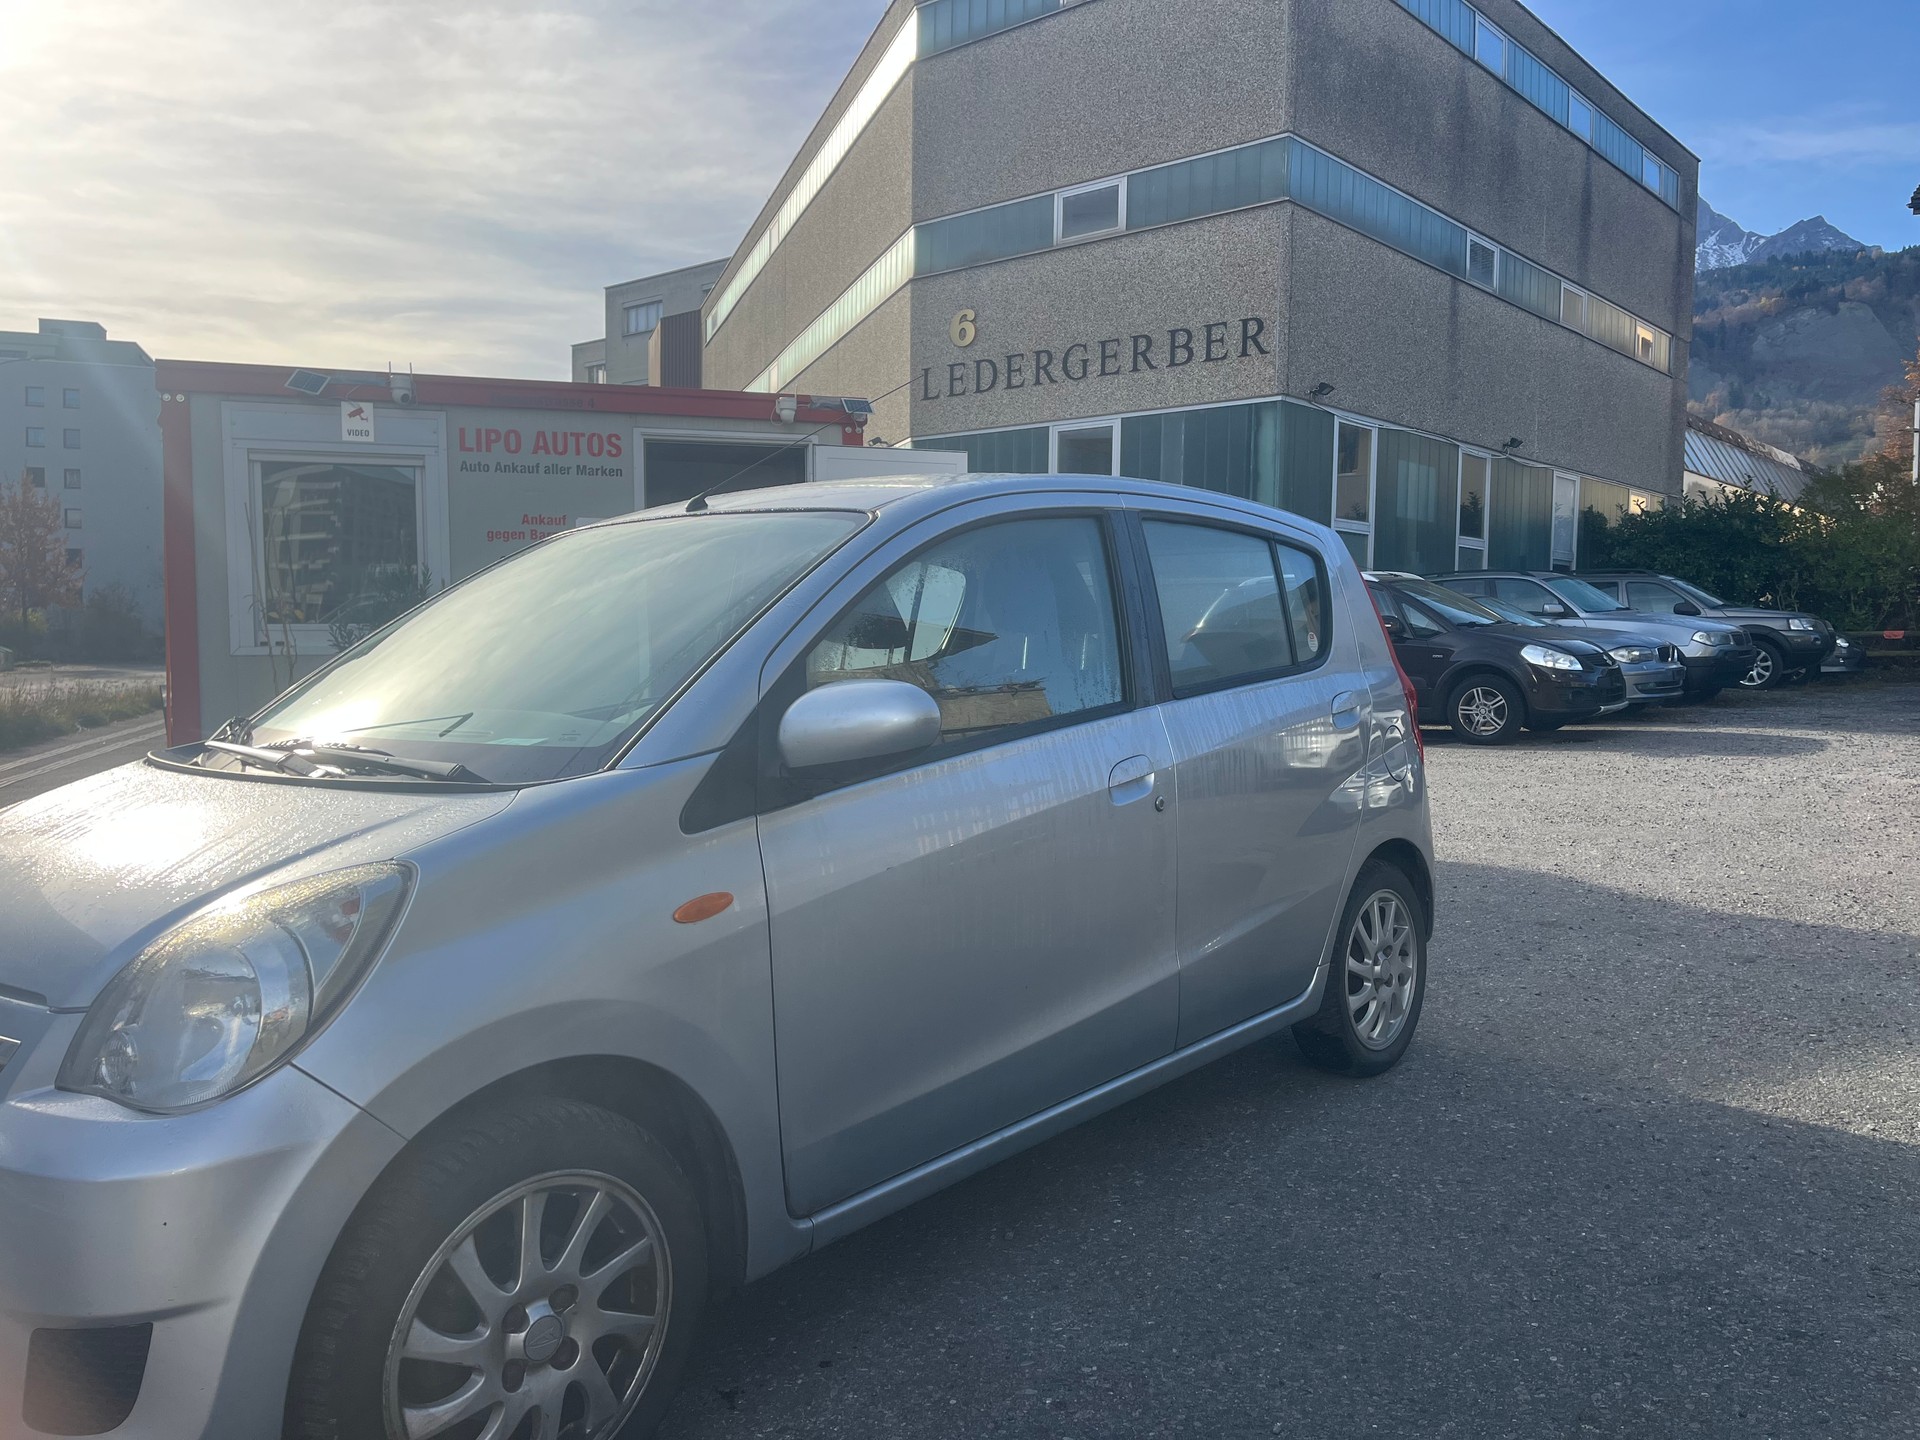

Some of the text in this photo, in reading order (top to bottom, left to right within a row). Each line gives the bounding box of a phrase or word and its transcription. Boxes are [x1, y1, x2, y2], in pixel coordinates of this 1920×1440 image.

[950, 308, 976, 347] 6
[921, 316, 1270, 401] LEDERGERBER
[347, 428, 370, 437] VIDEO
[458, 427, 623, 458] LIPO AUTOS
[460, 460, 623, 478] Auto Ankauf aller Marken
[521, 514, 567, 526] Ankauf
[487, 530, 525, 542] gegen
